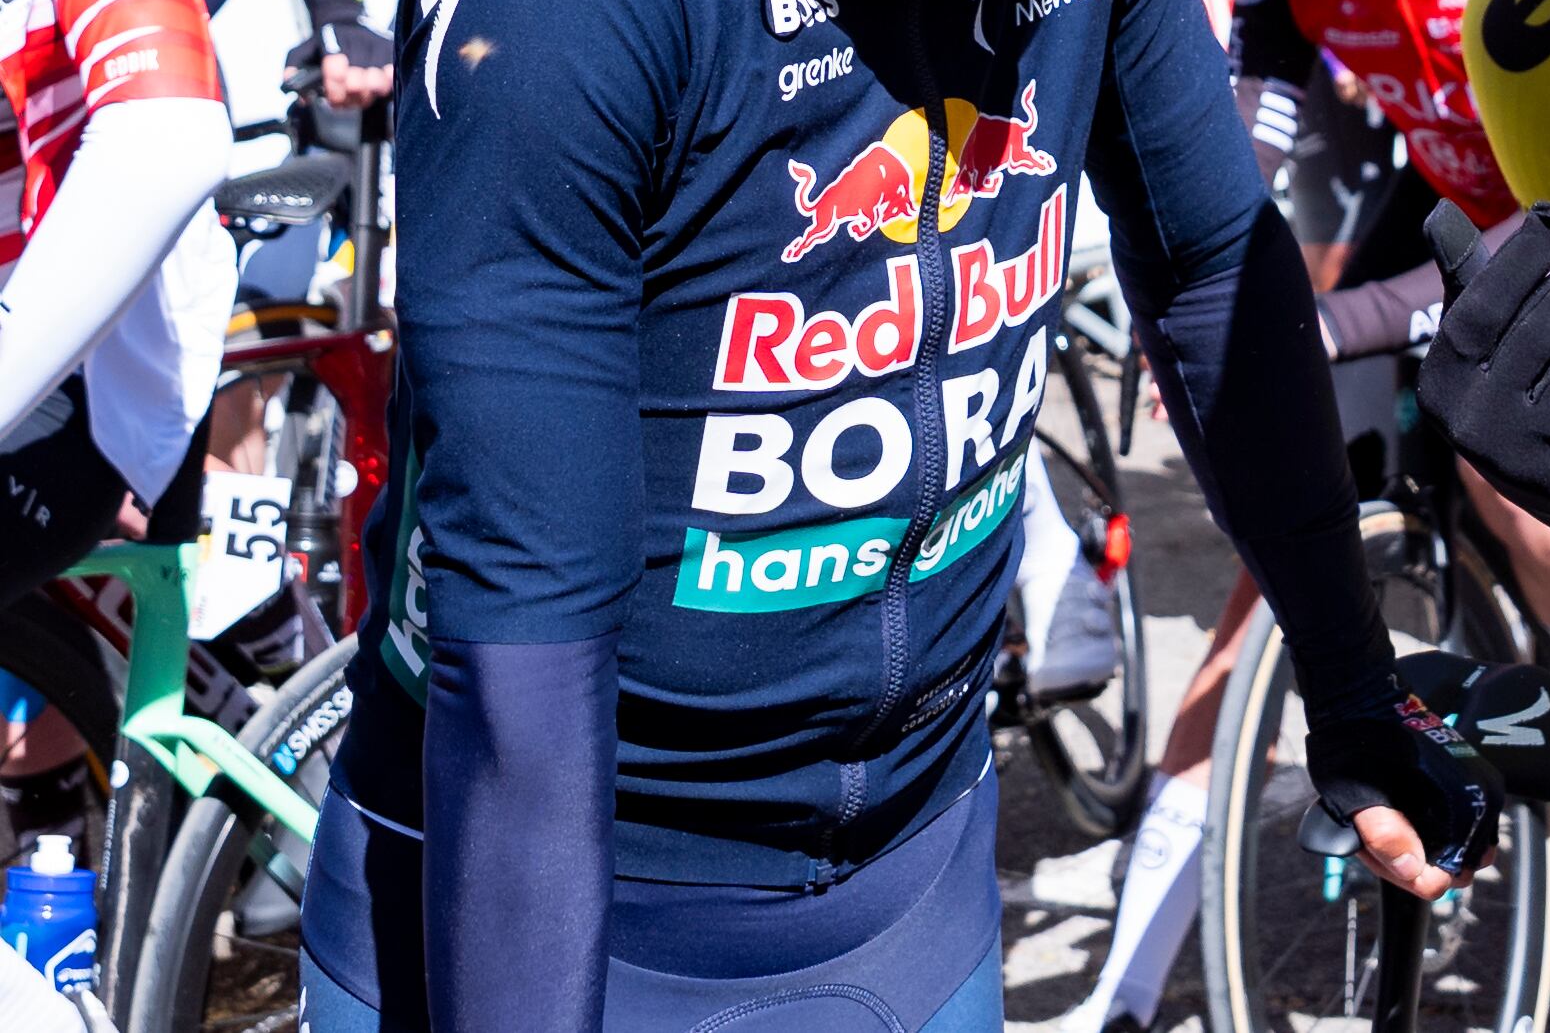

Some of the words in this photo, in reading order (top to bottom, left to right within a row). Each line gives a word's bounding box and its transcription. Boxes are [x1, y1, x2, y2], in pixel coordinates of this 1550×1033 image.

[778, 45, 855, 102] grenke
[713, 254, 925, 393] Red
[947, 183, 1068, 355] Bull
[691, 326, 1047, 515] BORA
[226, 497, 288, 564] 55
